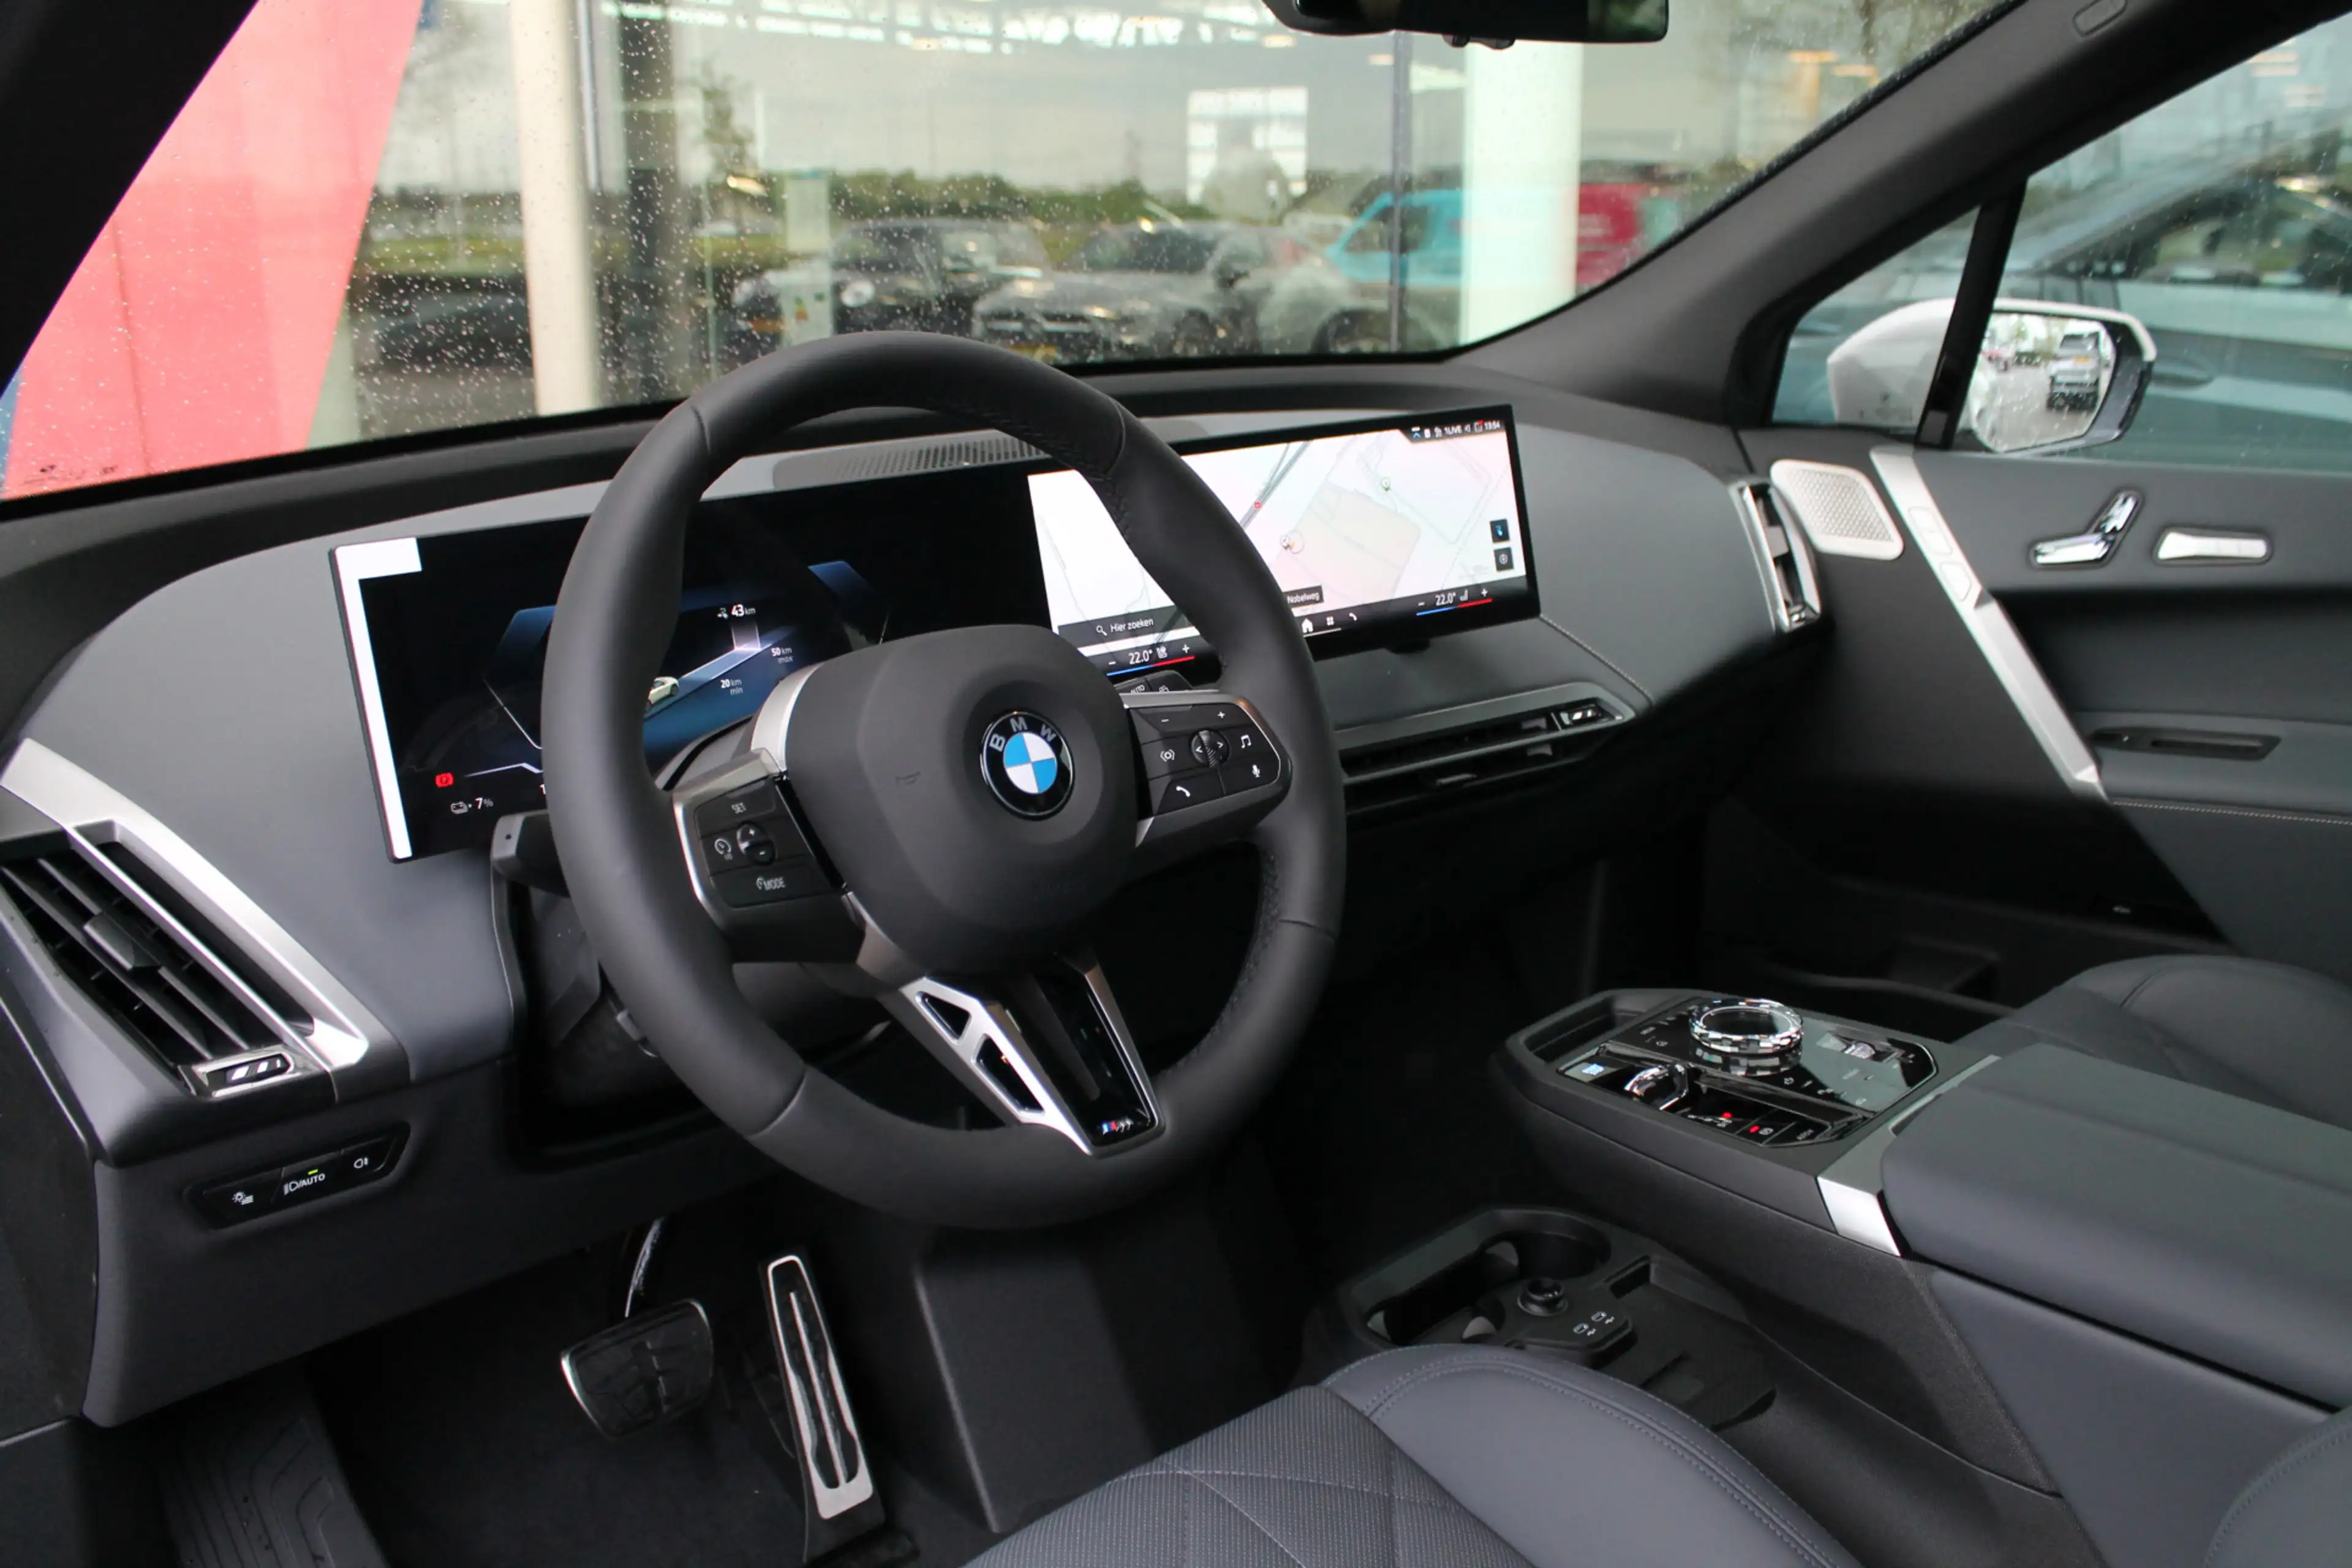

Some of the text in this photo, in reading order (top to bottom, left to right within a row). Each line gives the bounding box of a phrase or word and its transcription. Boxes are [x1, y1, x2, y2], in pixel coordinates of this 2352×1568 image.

[1287, 592, 1320, 604] Nobelweg
[731, 604, 744, 617] 43
[1110, 617, 1154, 633] Hier zoeken
[778, 655, 793, 664] max
[730, 686, 744, 696] min
[989, 717, 1057, 752] BMW
[731, 802, 747, 814] SET
[763, 876, 786, 891] MODE
